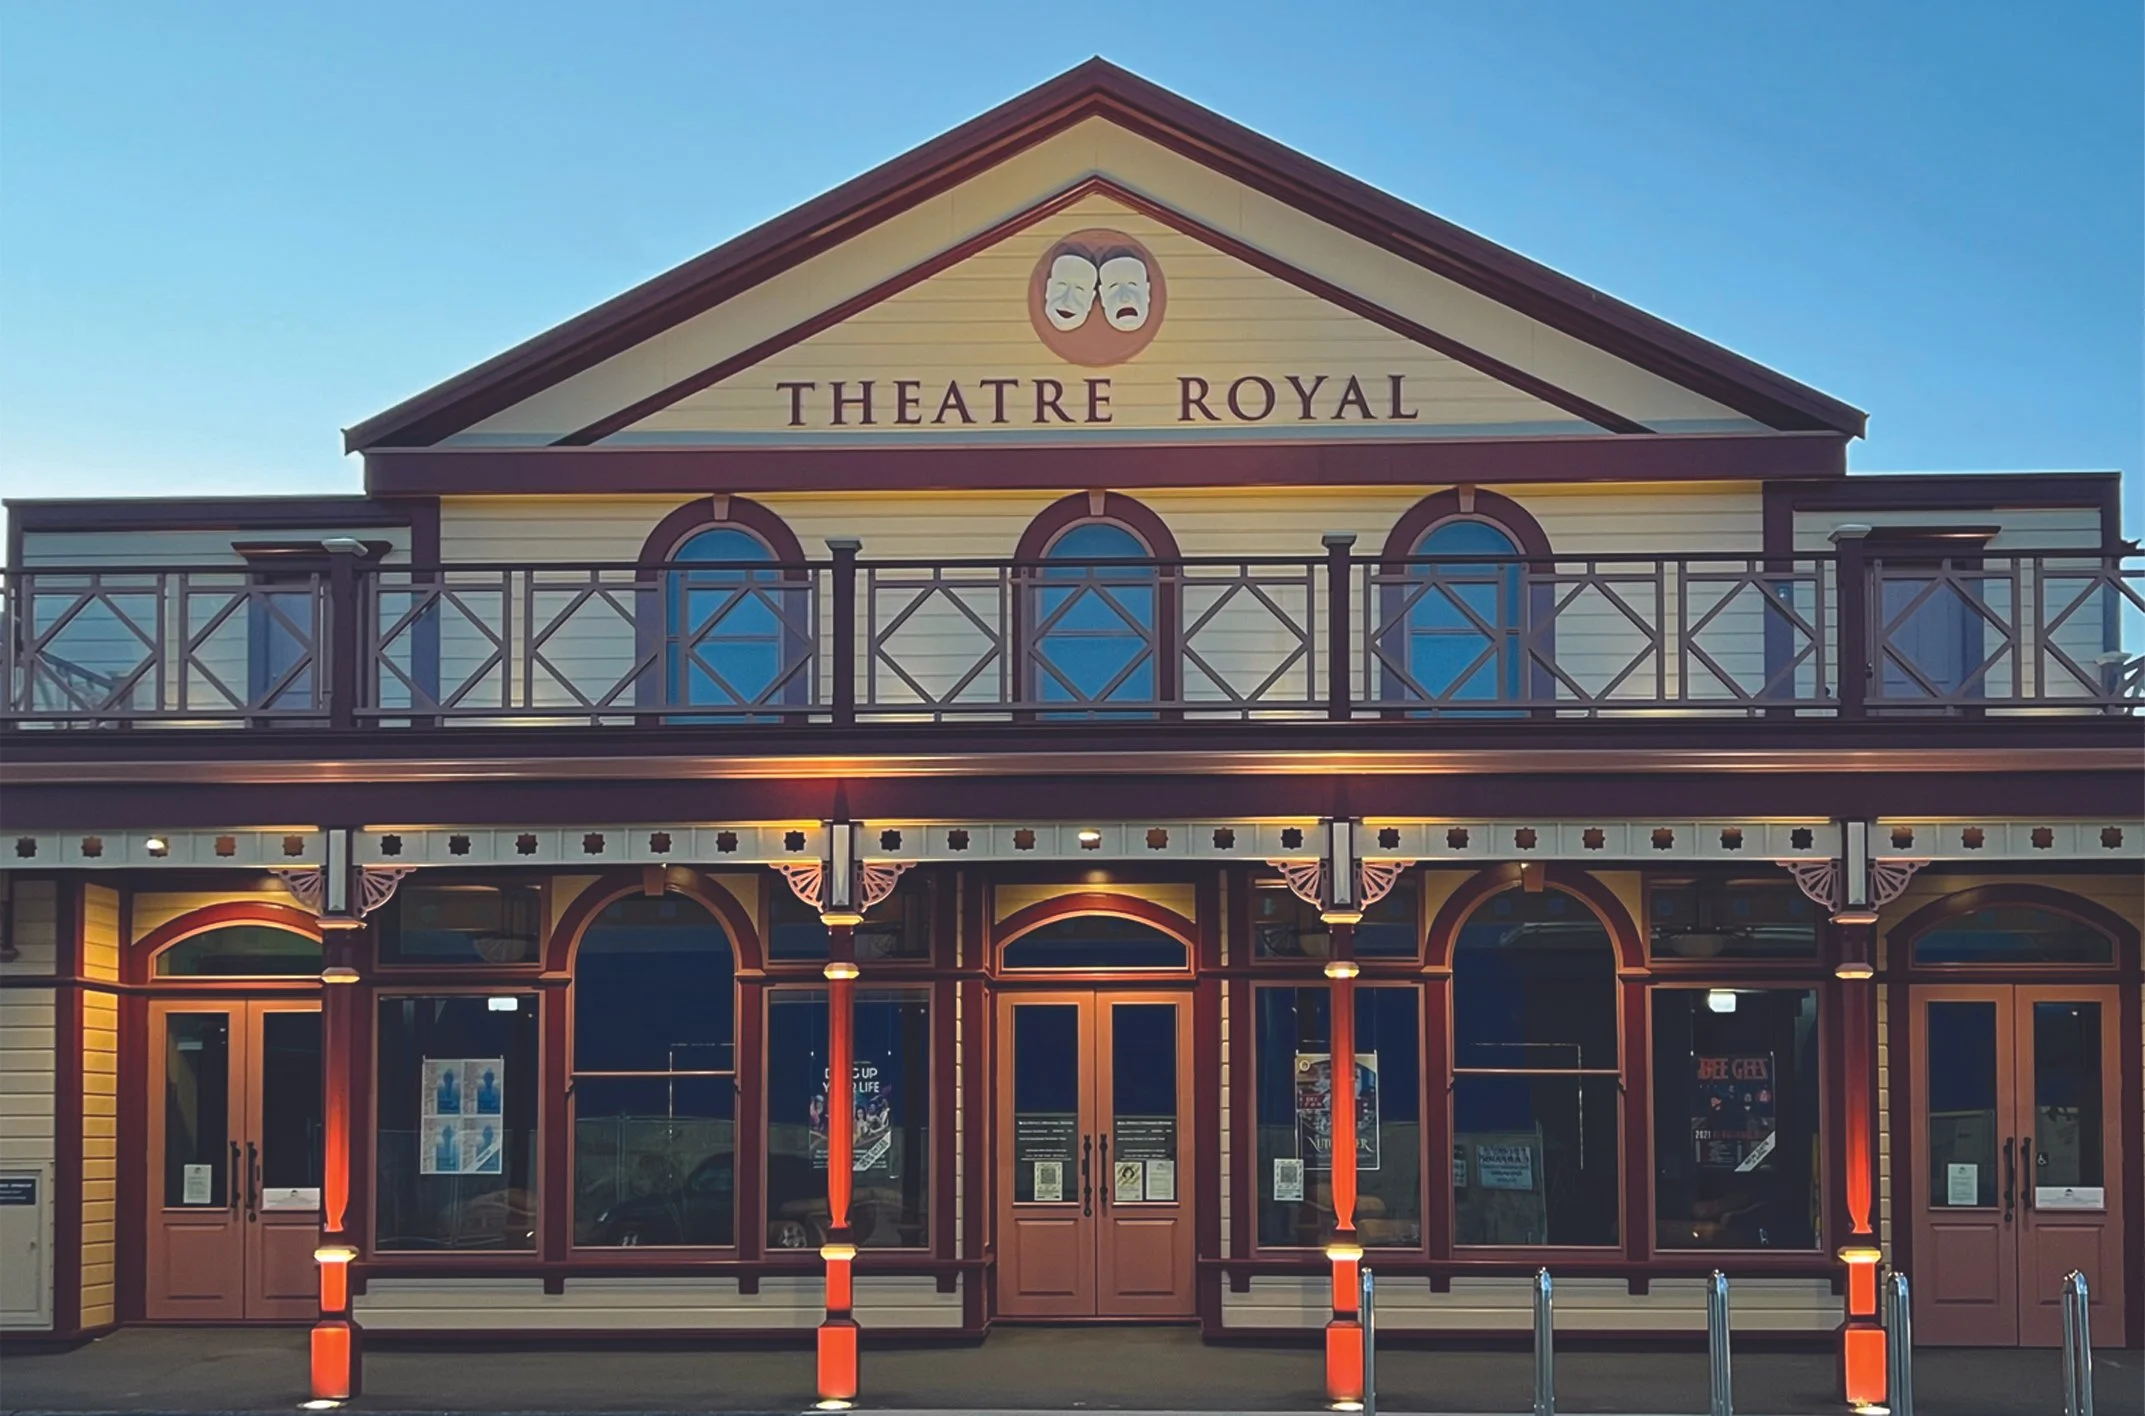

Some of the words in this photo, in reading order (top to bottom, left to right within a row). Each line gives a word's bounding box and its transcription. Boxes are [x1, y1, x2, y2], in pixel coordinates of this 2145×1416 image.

[776, 378, 1113, 426] THEATRE
[1177, 374, 1419, 422] ROYAL
[861, 1067, 878, 1079] UP
[1698, 1058, 1729, 1080] BEE
[859, 1081, 880, 1093] LIFE
